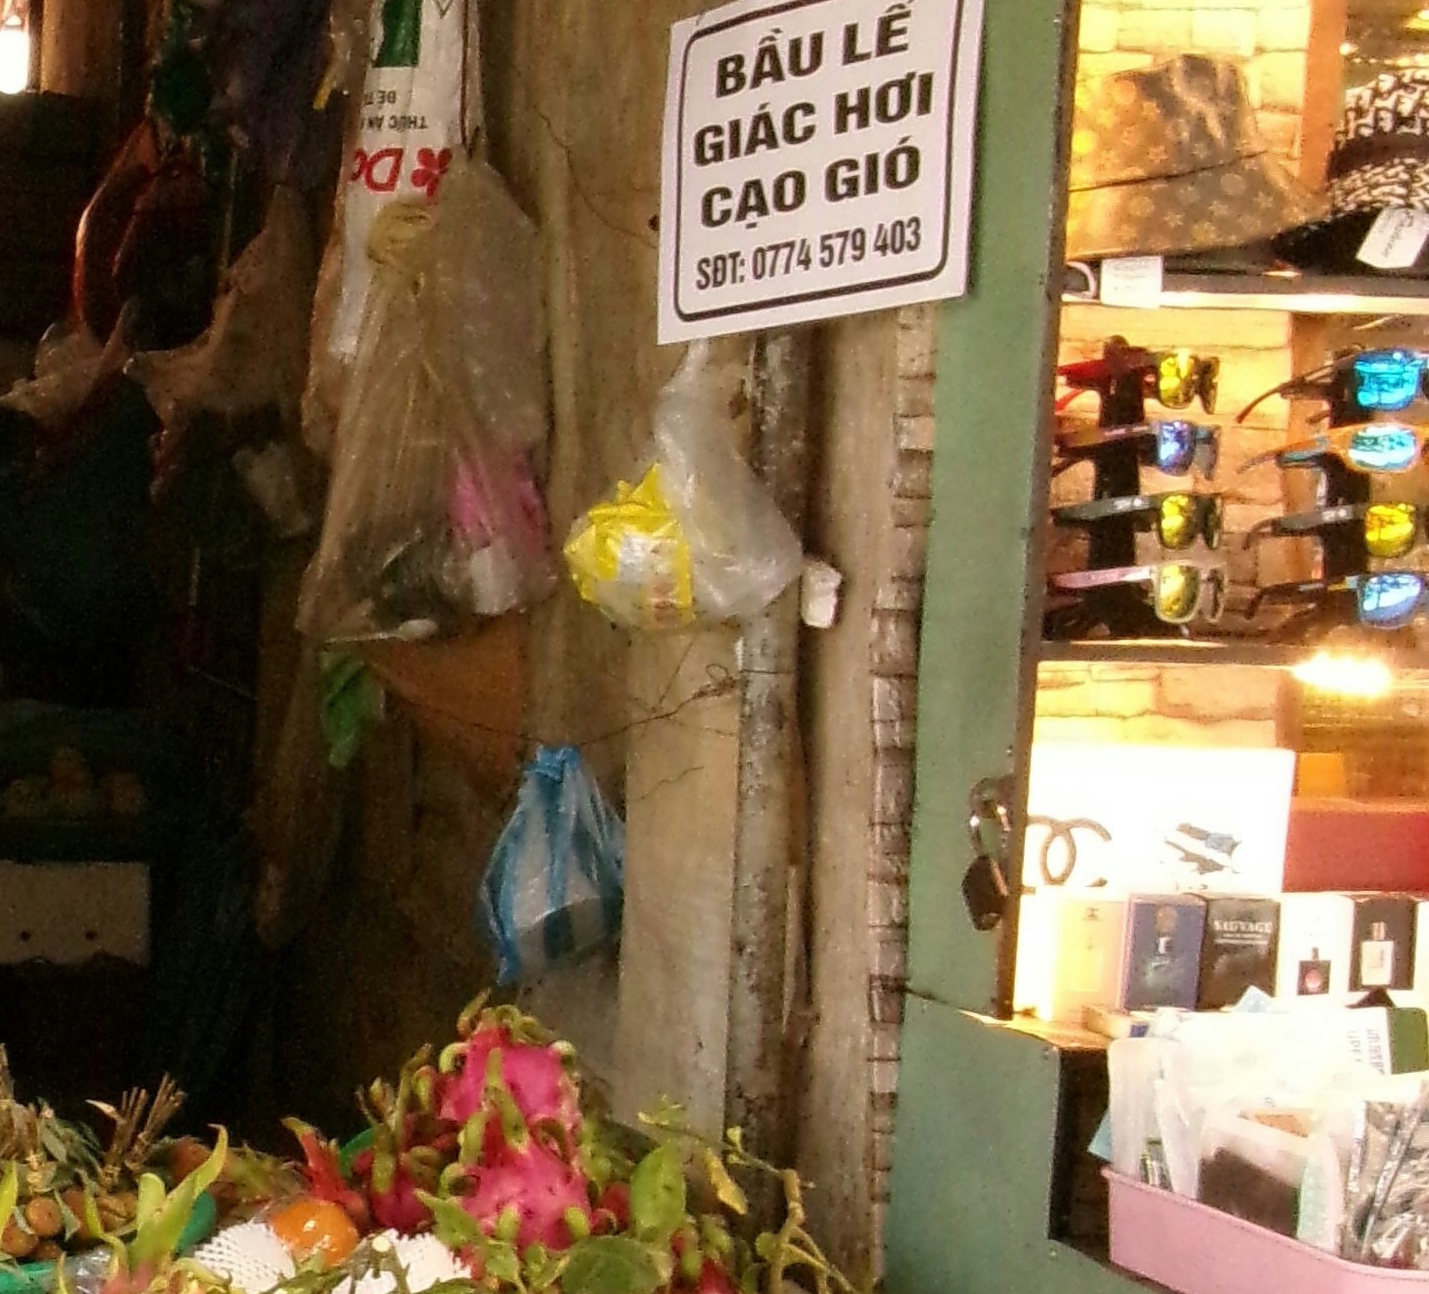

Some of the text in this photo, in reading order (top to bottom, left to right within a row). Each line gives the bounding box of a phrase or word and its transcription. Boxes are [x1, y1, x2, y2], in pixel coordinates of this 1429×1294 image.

[716, 28, 825, 99] BẦU
[693, 71, 934, 167] GIÁC HƠI
[700, 135, 921, 230] CẠO GIÓ
[696, 216, 922, 290] SĐT: 0774 579 403
